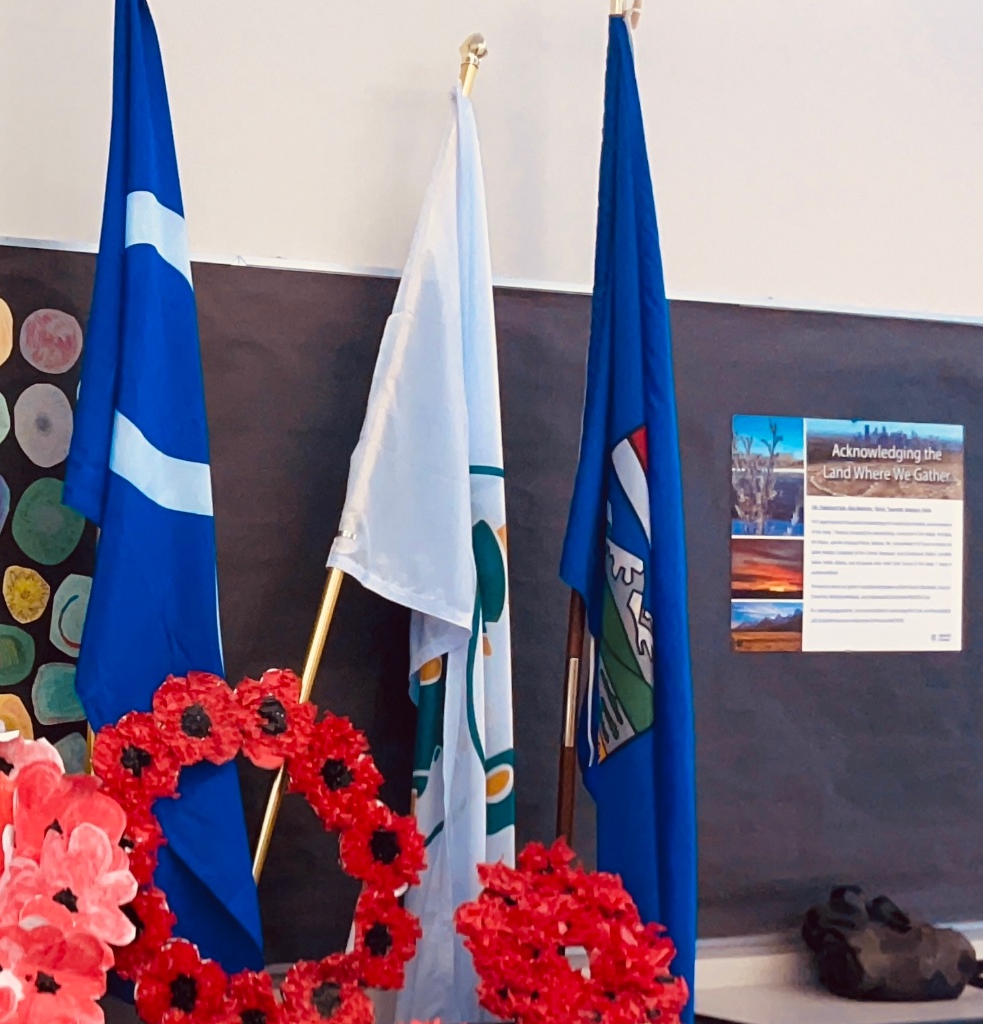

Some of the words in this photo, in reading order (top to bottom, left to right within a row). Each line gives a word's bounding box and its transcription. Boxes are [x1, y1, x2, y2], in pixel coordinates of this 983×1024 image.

[831, 443, 922, 463] Acknowledging
[923, 447, 943, 461] the
[823, 465, 852, 480] Land
[853, 466, 891, 481] Where
[892, 467, 911, 481] We
[913, 467, 951, 482] Gather
